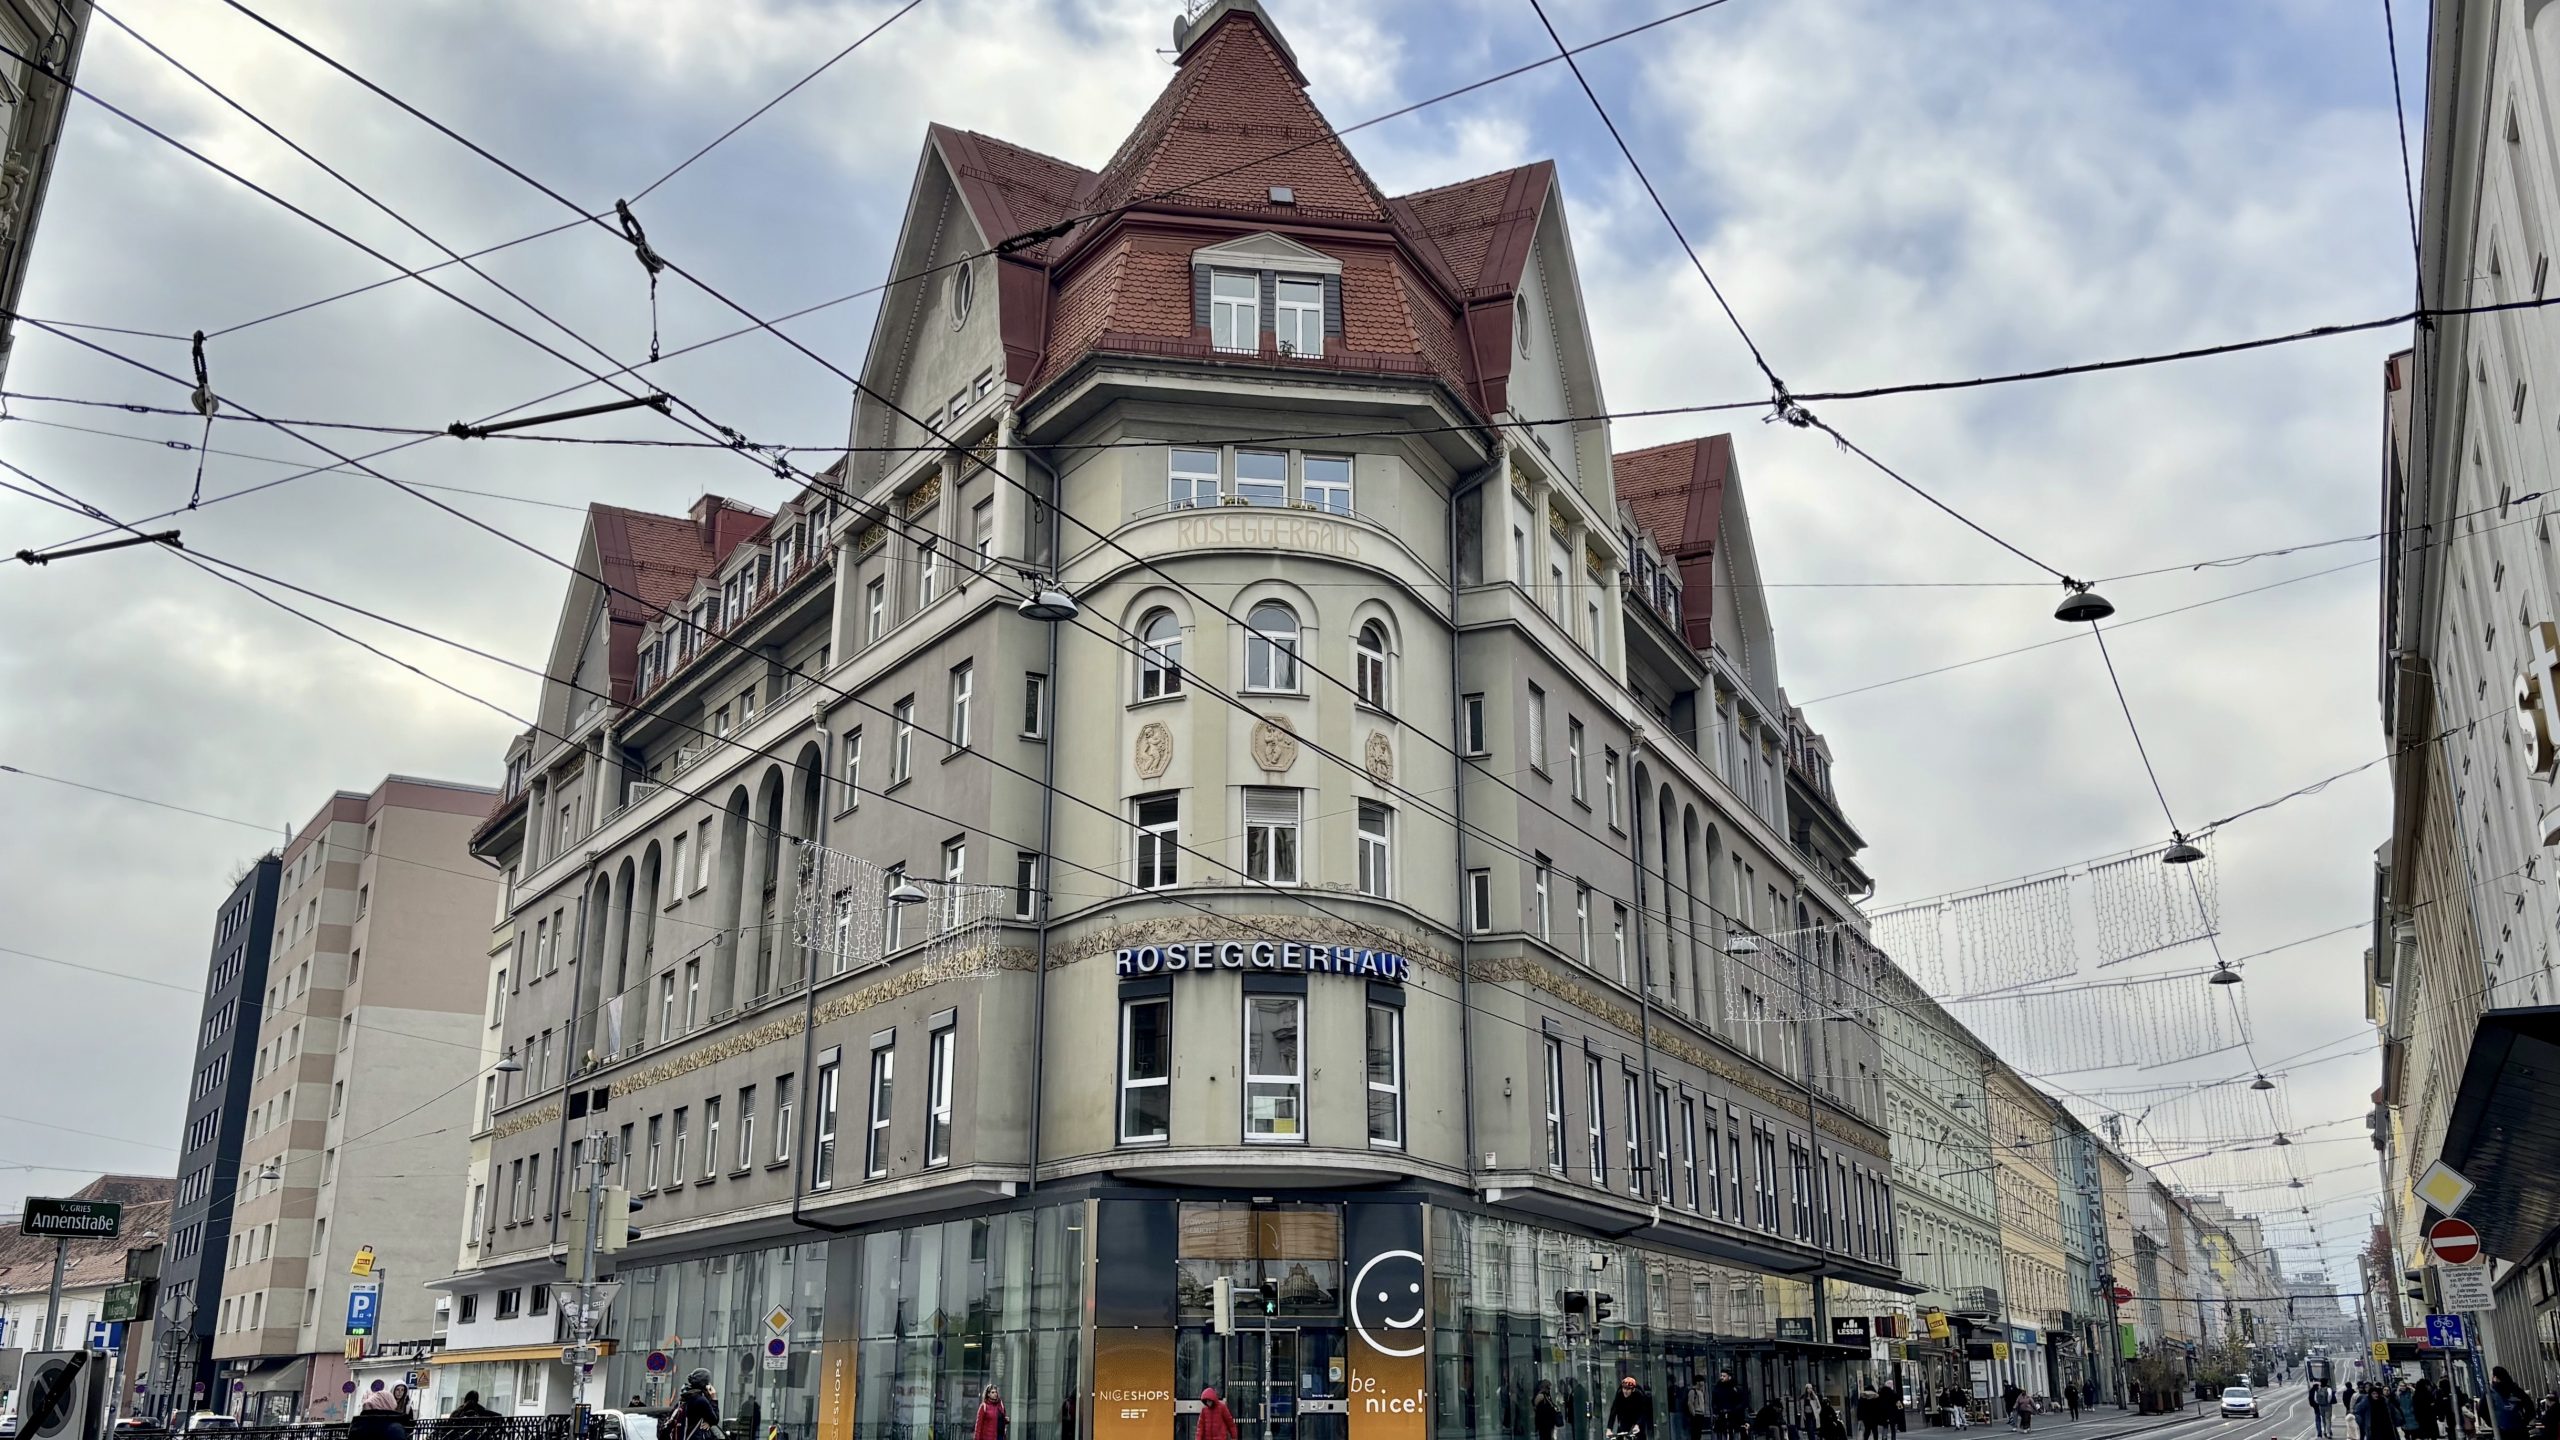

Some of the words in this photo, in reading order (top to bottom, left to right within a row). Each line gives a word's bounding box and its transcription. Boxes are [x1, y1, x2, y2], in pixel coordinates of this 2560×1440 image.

[1115, 940, 1411, 984] ROSEGGERHAUS
[70, 1204, 92, 1213] GRIES
[31, 1212, 114, 1231] Annenstraße
[352, 1295, 370, 1318] P
[1351, 1368, 1376, 1393] be
[1099, 1389, 1170, 1401] NICESHOPS
[1366, 1388, 1424, 1413] nice!
